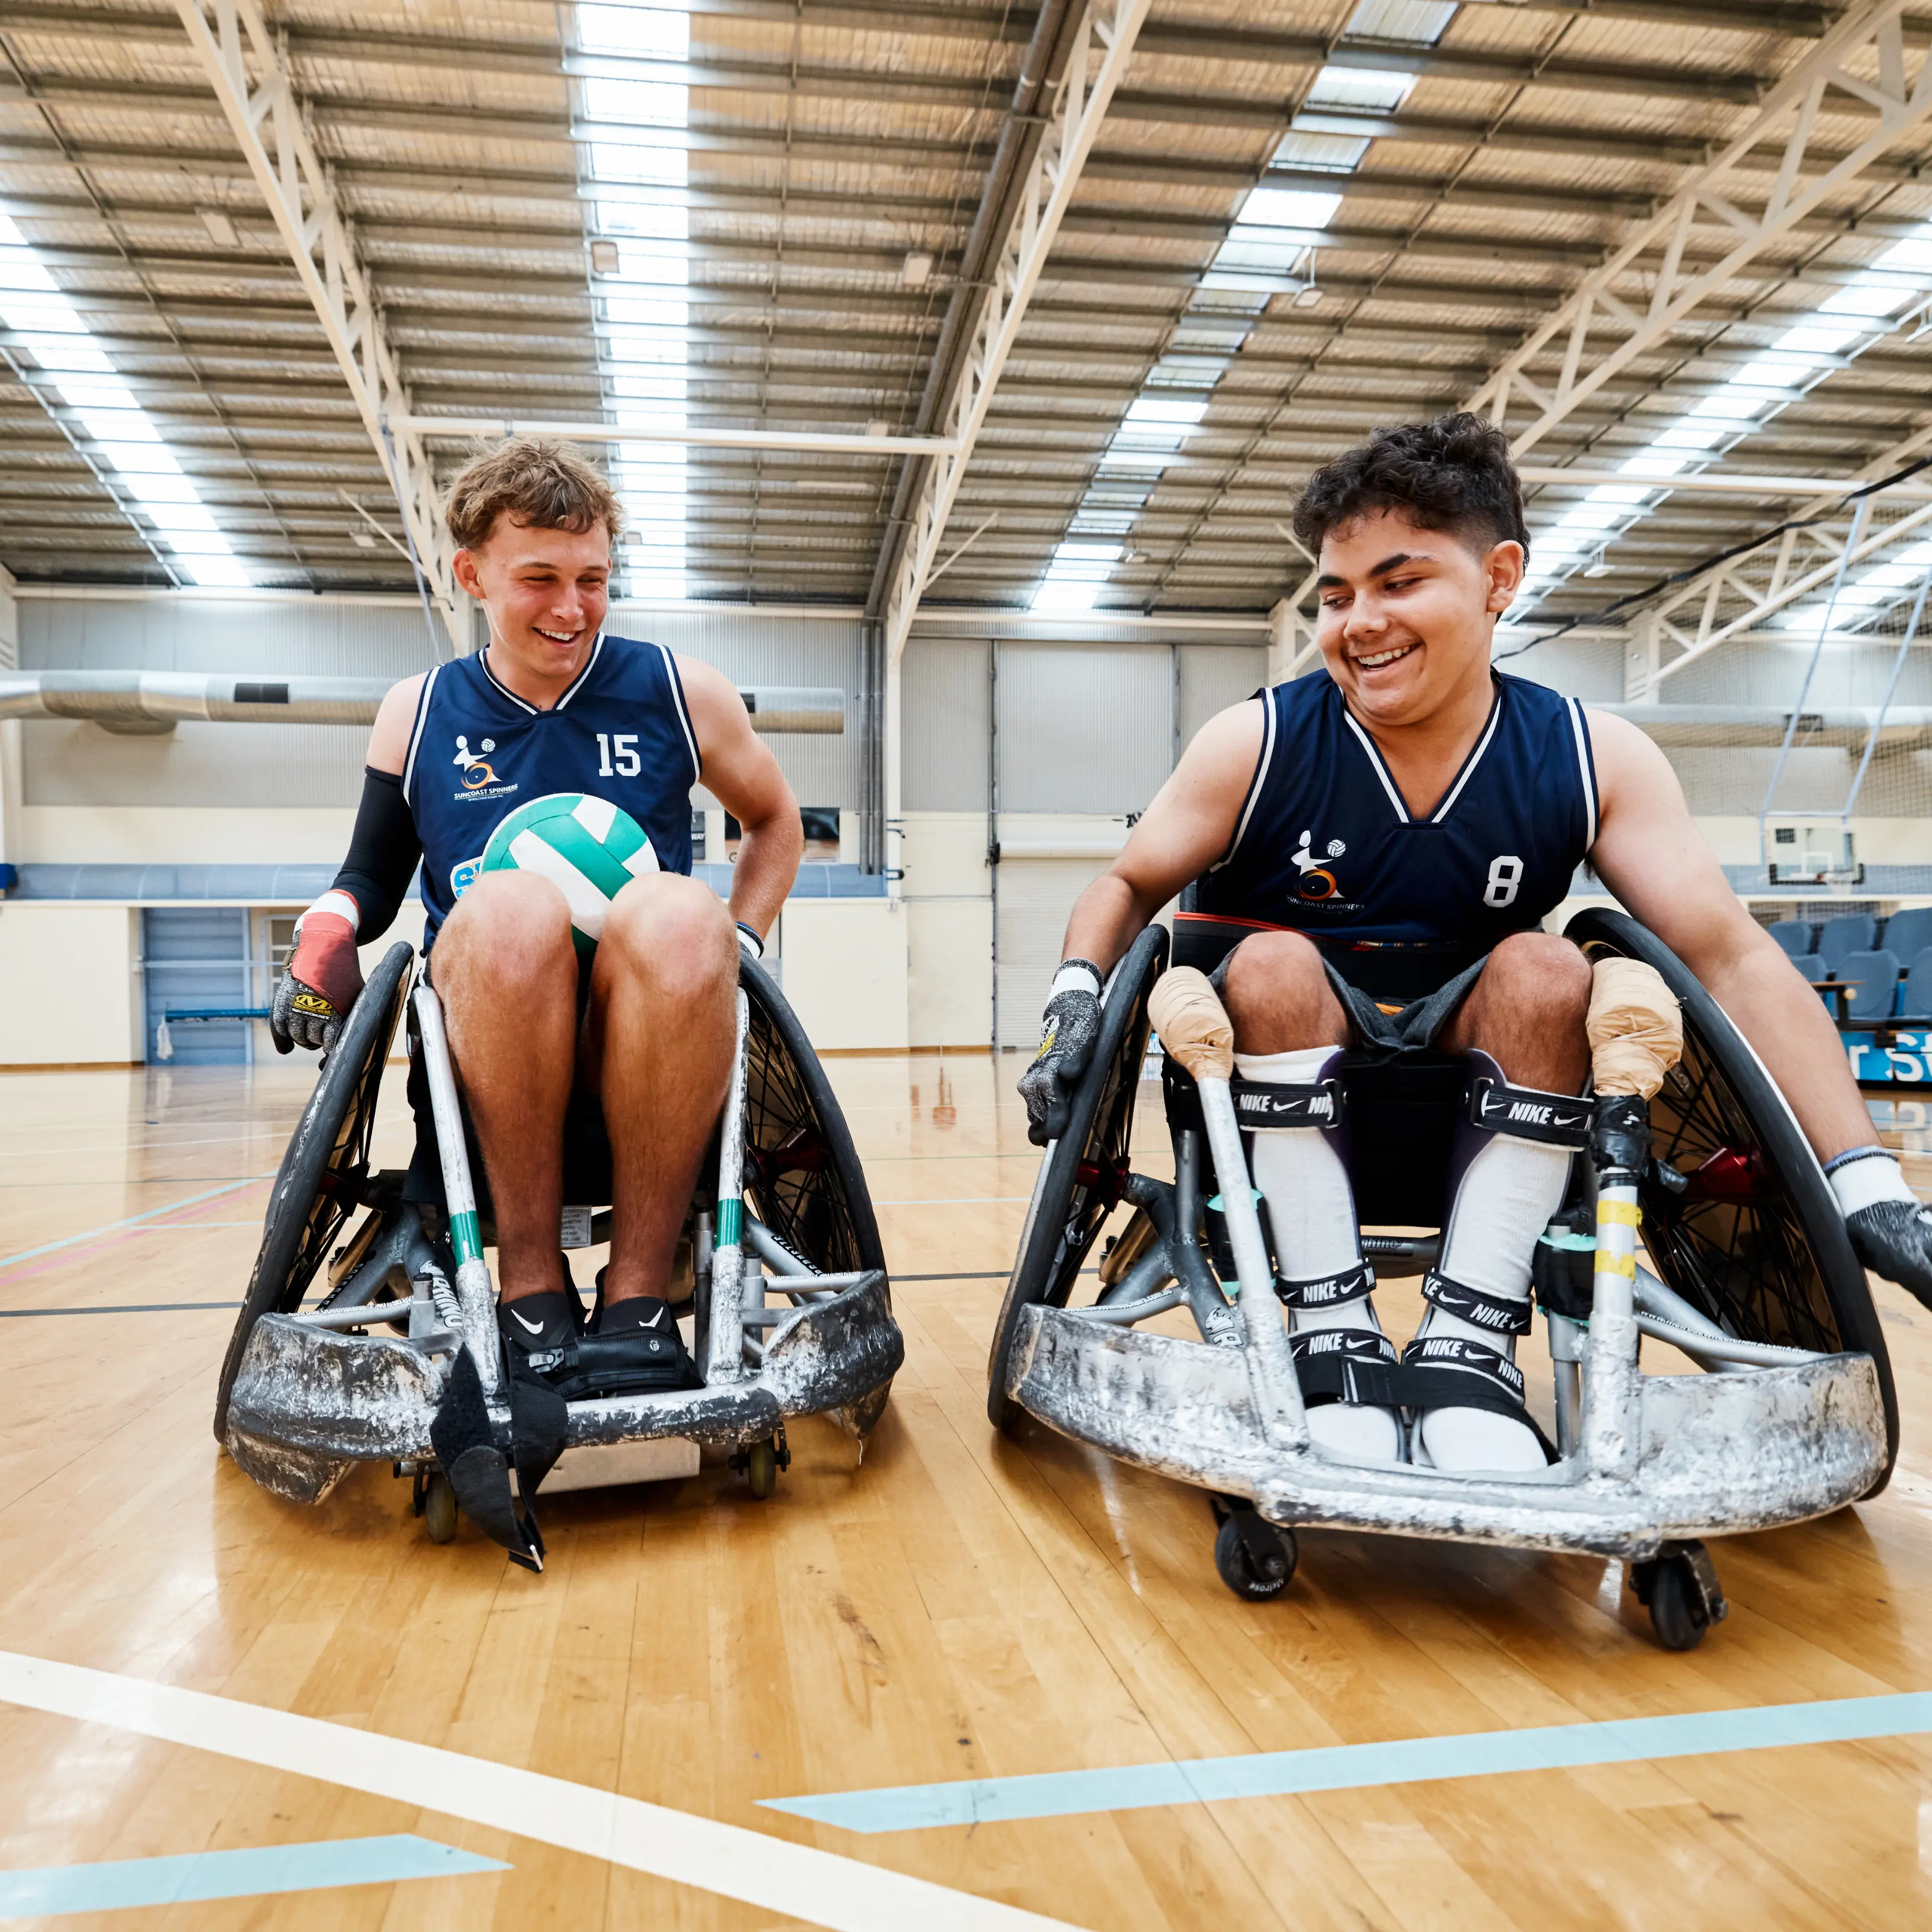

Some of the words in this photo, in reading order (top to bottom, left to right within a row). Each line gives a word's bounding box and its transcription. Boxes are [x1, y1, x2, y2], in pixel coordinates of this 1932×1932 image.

[596, 733, 641, 777] 15
[453, 788, 488, 799] SUNCOAST
[488, 783, 519, 794] SPINNERS
[691, 833, 705, 841] WAY
[1482, 855, 1524, 908] 8
[1285, 894, 1325, 909] SUNCOAST
[1239, 1093, 1272, 1113] NIKE
[1507, 1102, 1553, 1125] NIKE
[1303, 1280, 1337, 1303] NIKE
[1469, 1303, 1512, 1329] NIKE
[1308, 1332, 1344, 1355] NIKE
[1421, 1339, 1464, 1358] NIKE
[1497, 1358, 1523, 1389] NIKE
[1249, 1576, 1284, 1593] Melrose
